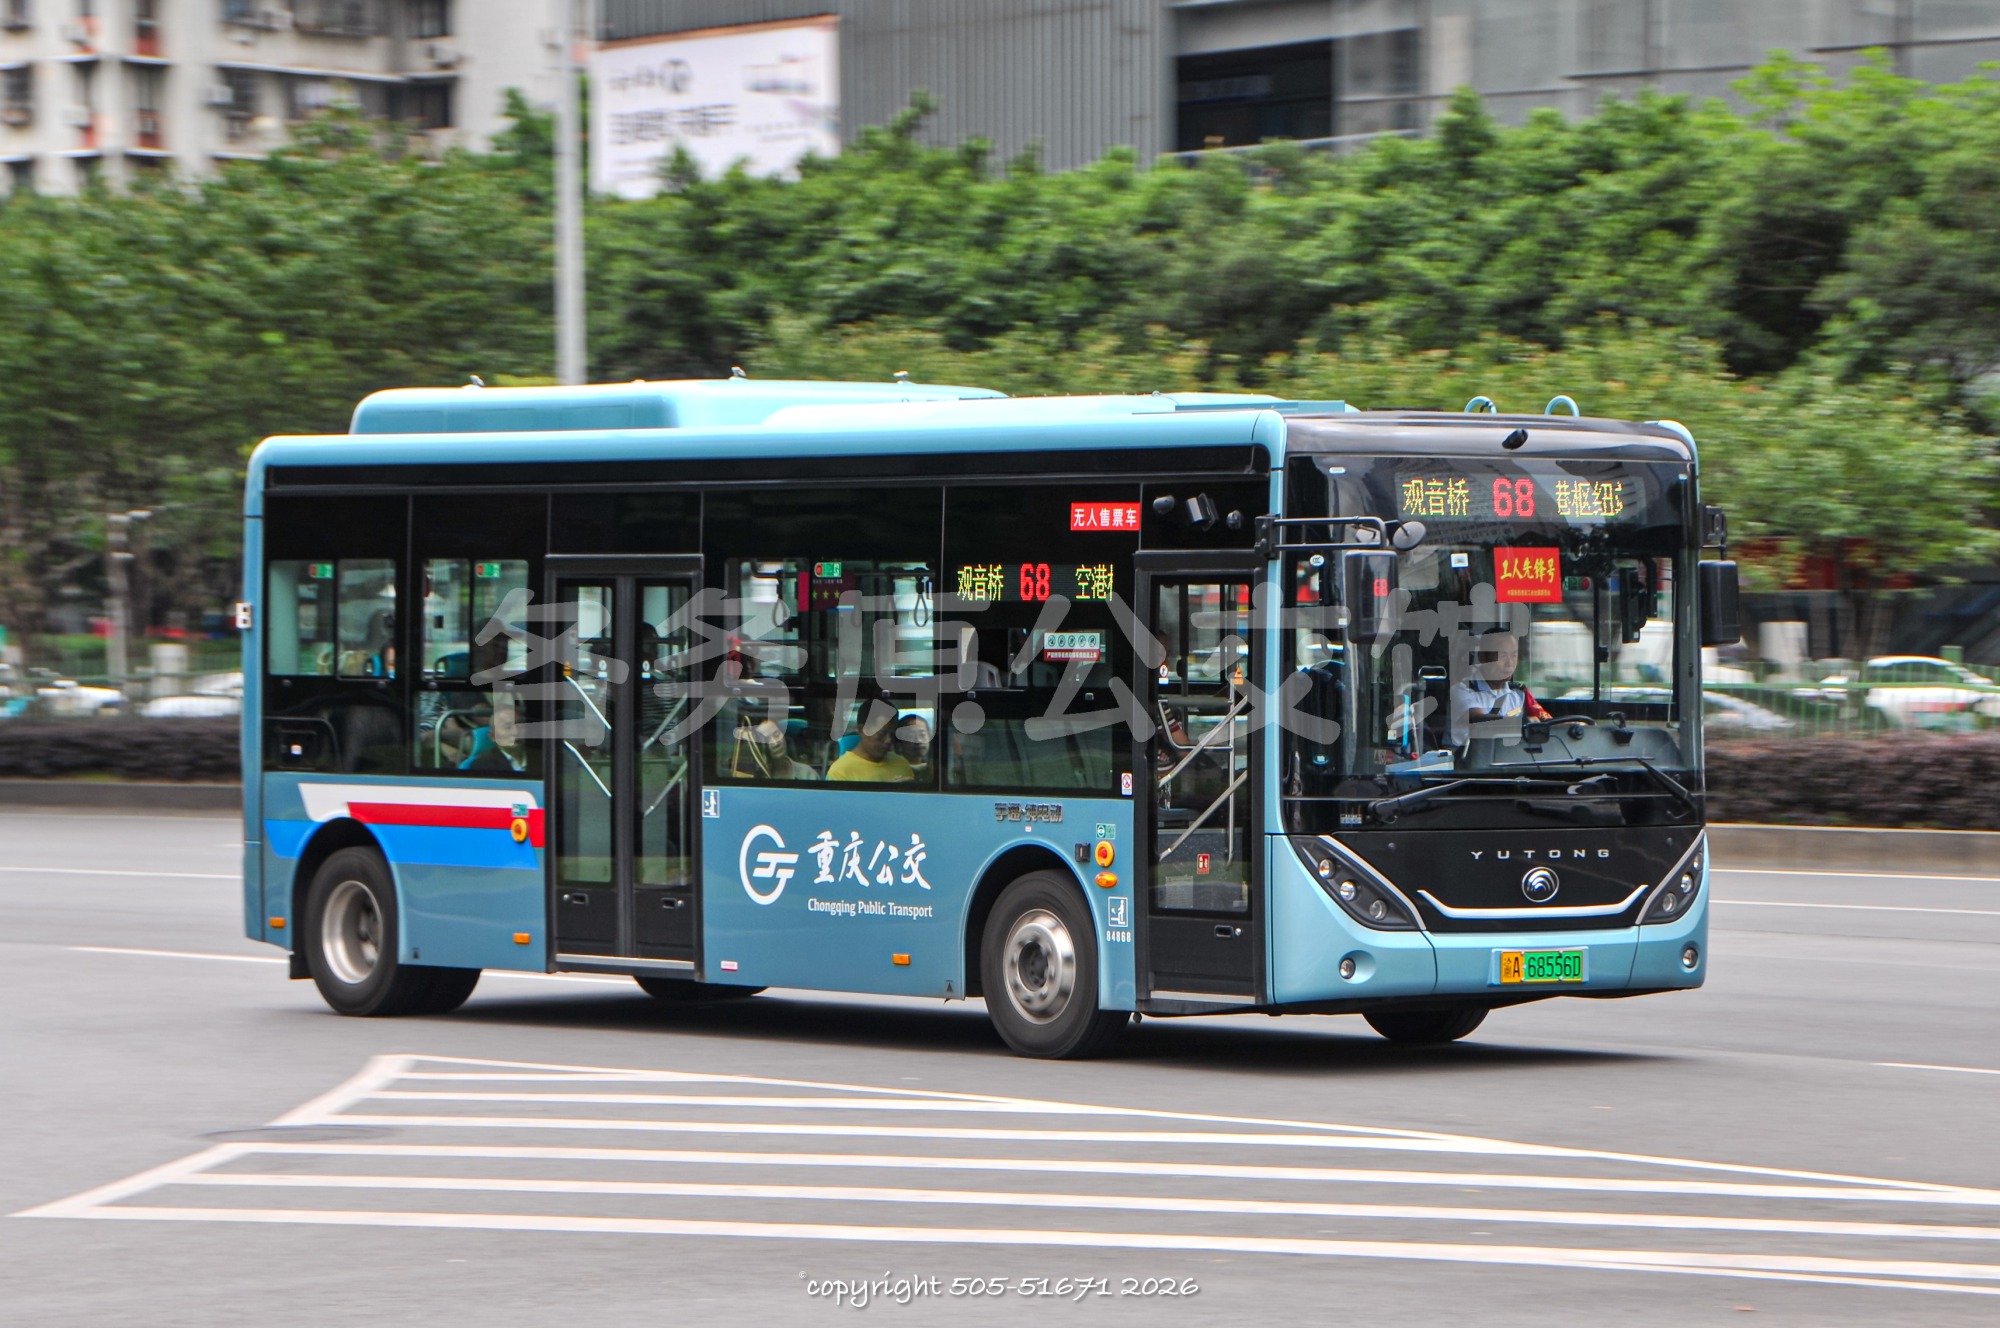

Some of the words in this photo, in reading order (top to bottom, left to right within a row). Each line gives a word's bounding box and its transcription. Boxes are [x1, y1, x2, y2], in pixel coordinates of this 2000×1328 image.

[1402, 478, 1469, 516] 观音桥
[1492, 478, 1536, 517] 68
[1073, 507, 1136, 527] 无人售票车
[957, 564, 1004, 601] 观音桥
[1020, 563, 1050, 601] 68
[1500, 557, 1556, 583] 工人先锋号
[807, 831, 931, 890] 重庆公交
[1471, 849, 1610, 860] YUTONG
[807, 898, 856, 917] Chongqing
[858, 901, 886, 915] Public
[888, 902, 933, 920] Transport
[1106, 930, 1131, 943] 84868
